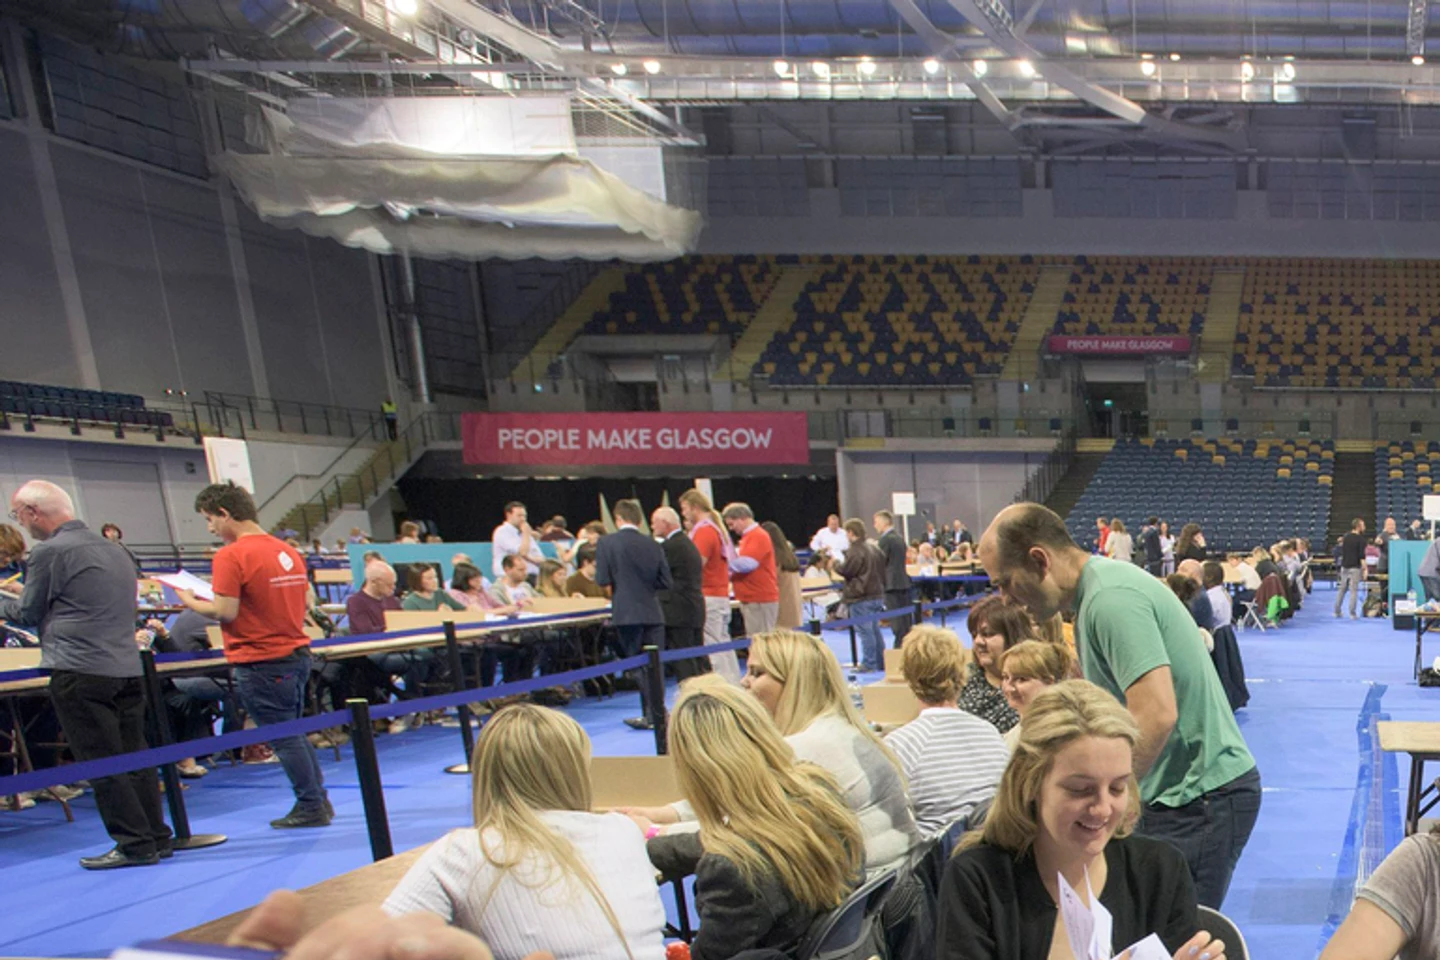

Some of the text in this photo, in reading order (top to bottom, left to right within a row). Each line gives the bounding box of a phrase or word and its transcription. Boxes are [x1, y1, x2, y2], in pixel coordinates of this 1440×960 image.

[1127, 340, 1173, 350] GLASGOW
[498, 428, 773, 450] PEOPLE MAKE GLASGOW
